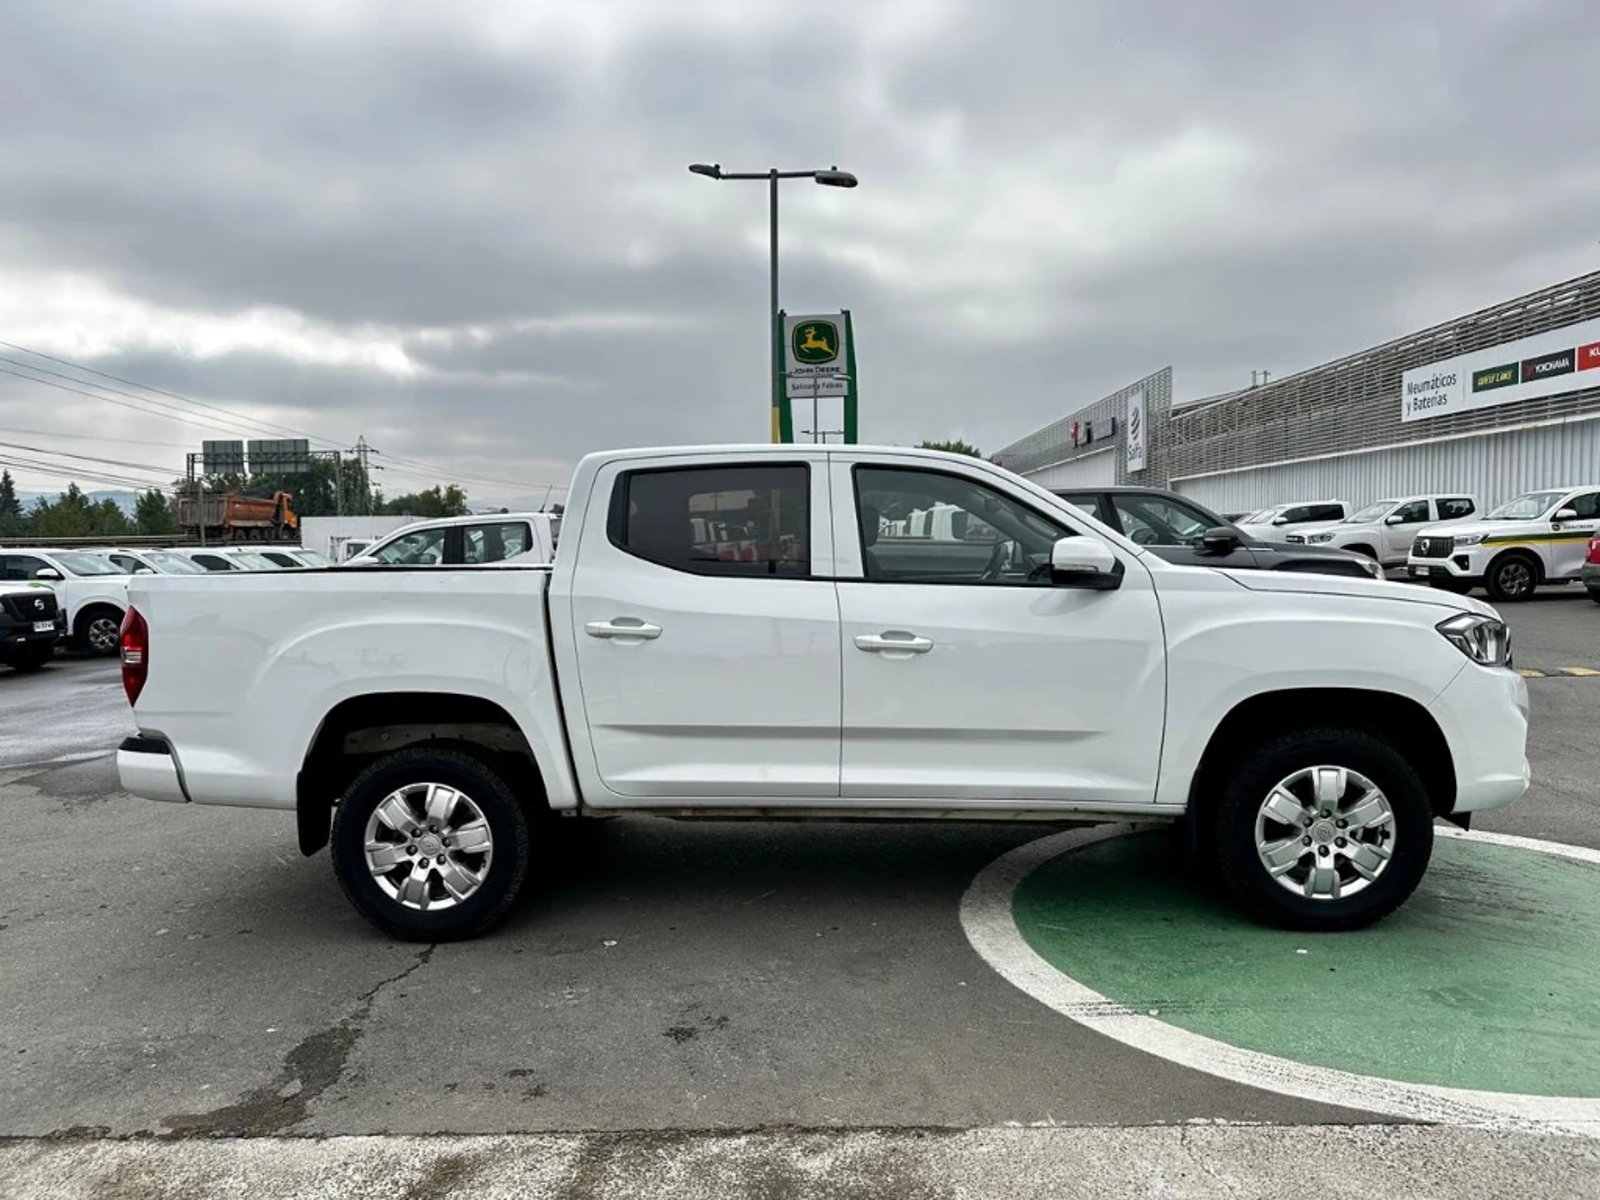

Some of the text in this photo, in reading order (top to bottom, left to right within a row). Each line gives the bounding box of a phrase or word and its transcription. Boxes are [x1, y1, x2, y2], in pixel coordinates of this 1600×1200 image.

[794, 367, 813, 375] JOHN
[1535, 358, 1570, 374] YOKOHAMA
[1407, 373, 1457, 395] Neumáticos
[1406, 390, 1448, 416] y Baterías
